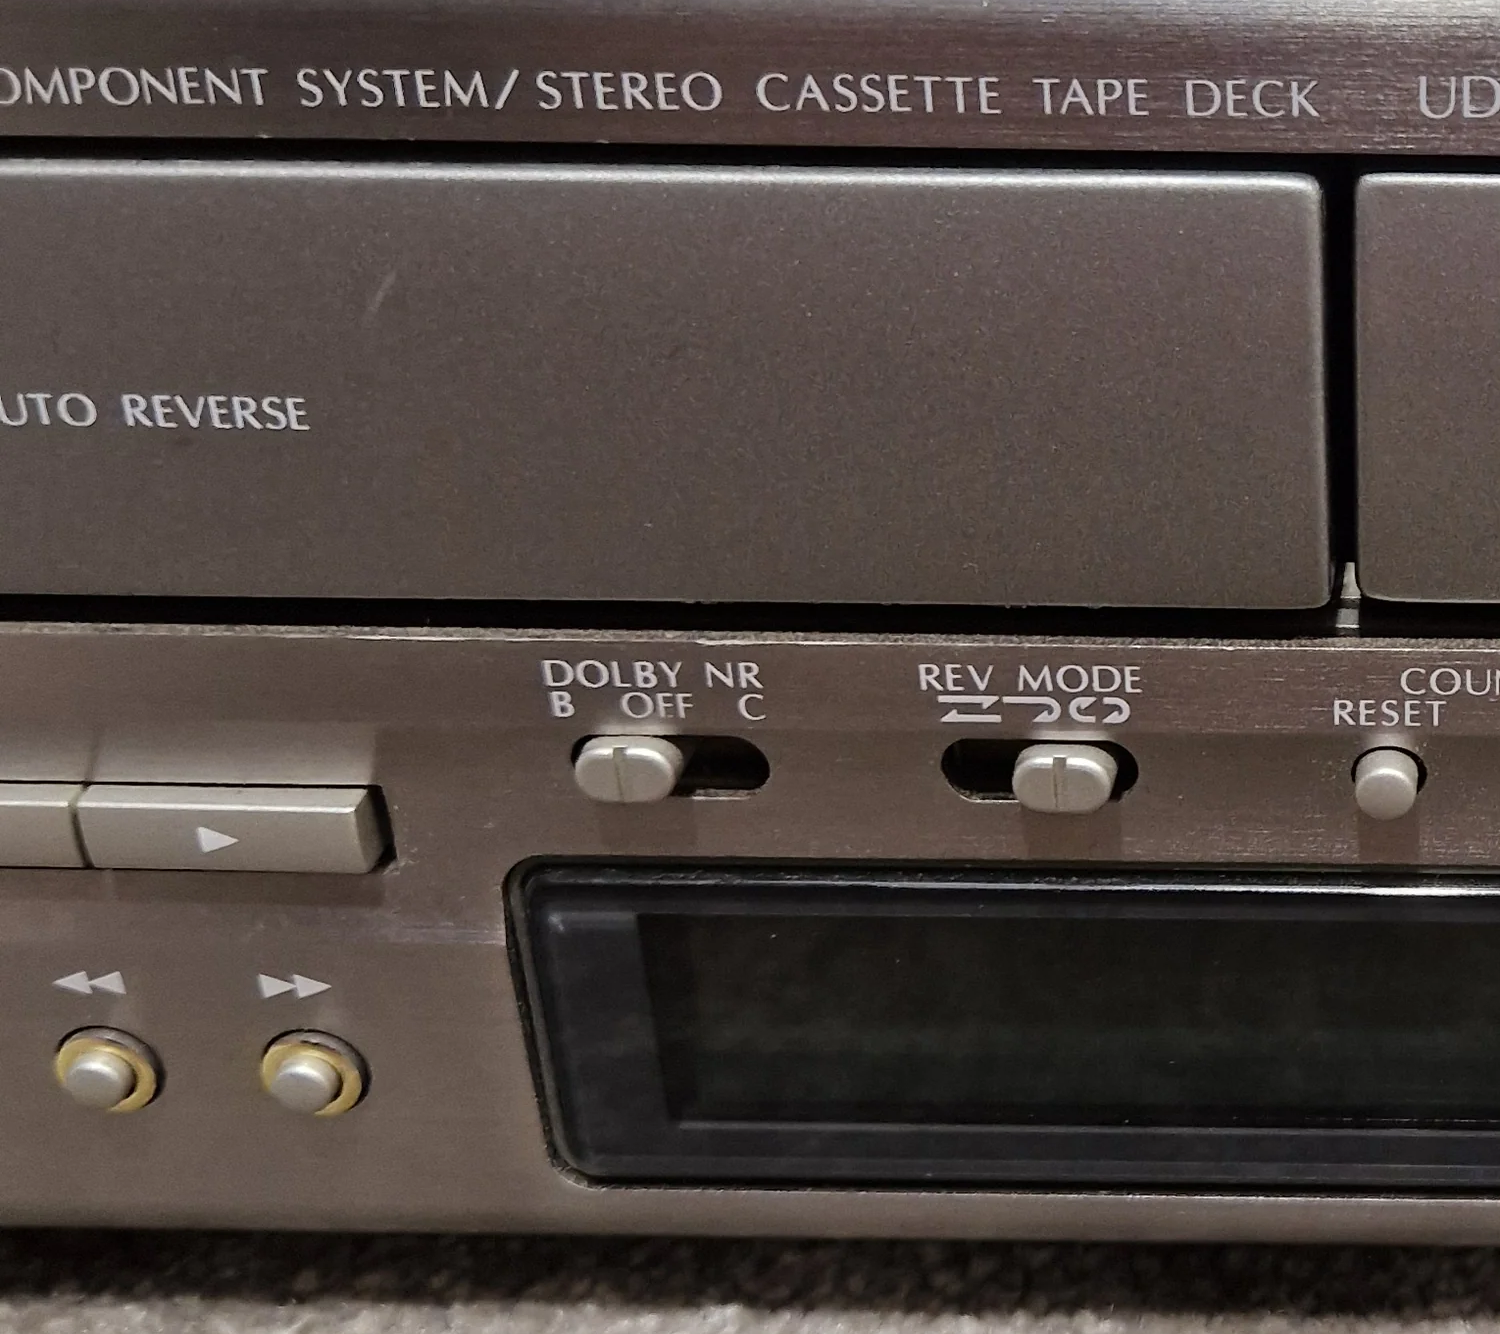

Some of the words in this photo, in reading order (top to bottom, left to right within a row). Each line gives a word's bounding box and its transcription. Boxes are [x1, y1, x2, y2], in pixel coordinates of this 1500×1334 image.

[296, 69, 519, 110] SYSTEM/
[537, 72, 723, 111] STEREO
[756, 73, 1000, 114] CASSETTE
[1034, 78, 1148, 116] TAPE
[1184, 80, 1320, 119] DECK
[121, 395, 310, 431] REVERSE
[541, 659, 681, 689] DOLBY
[705, 662, 763, 689] NR
[918, 663, 993, 692] REV
[1017, 665, 1140, 693] MODE
[549, 691, 574, 718] B
[619, 693, 693, 719] OFF
[737, 694, 766, 721] C
[1332, 699, 1447, 728] RESET
